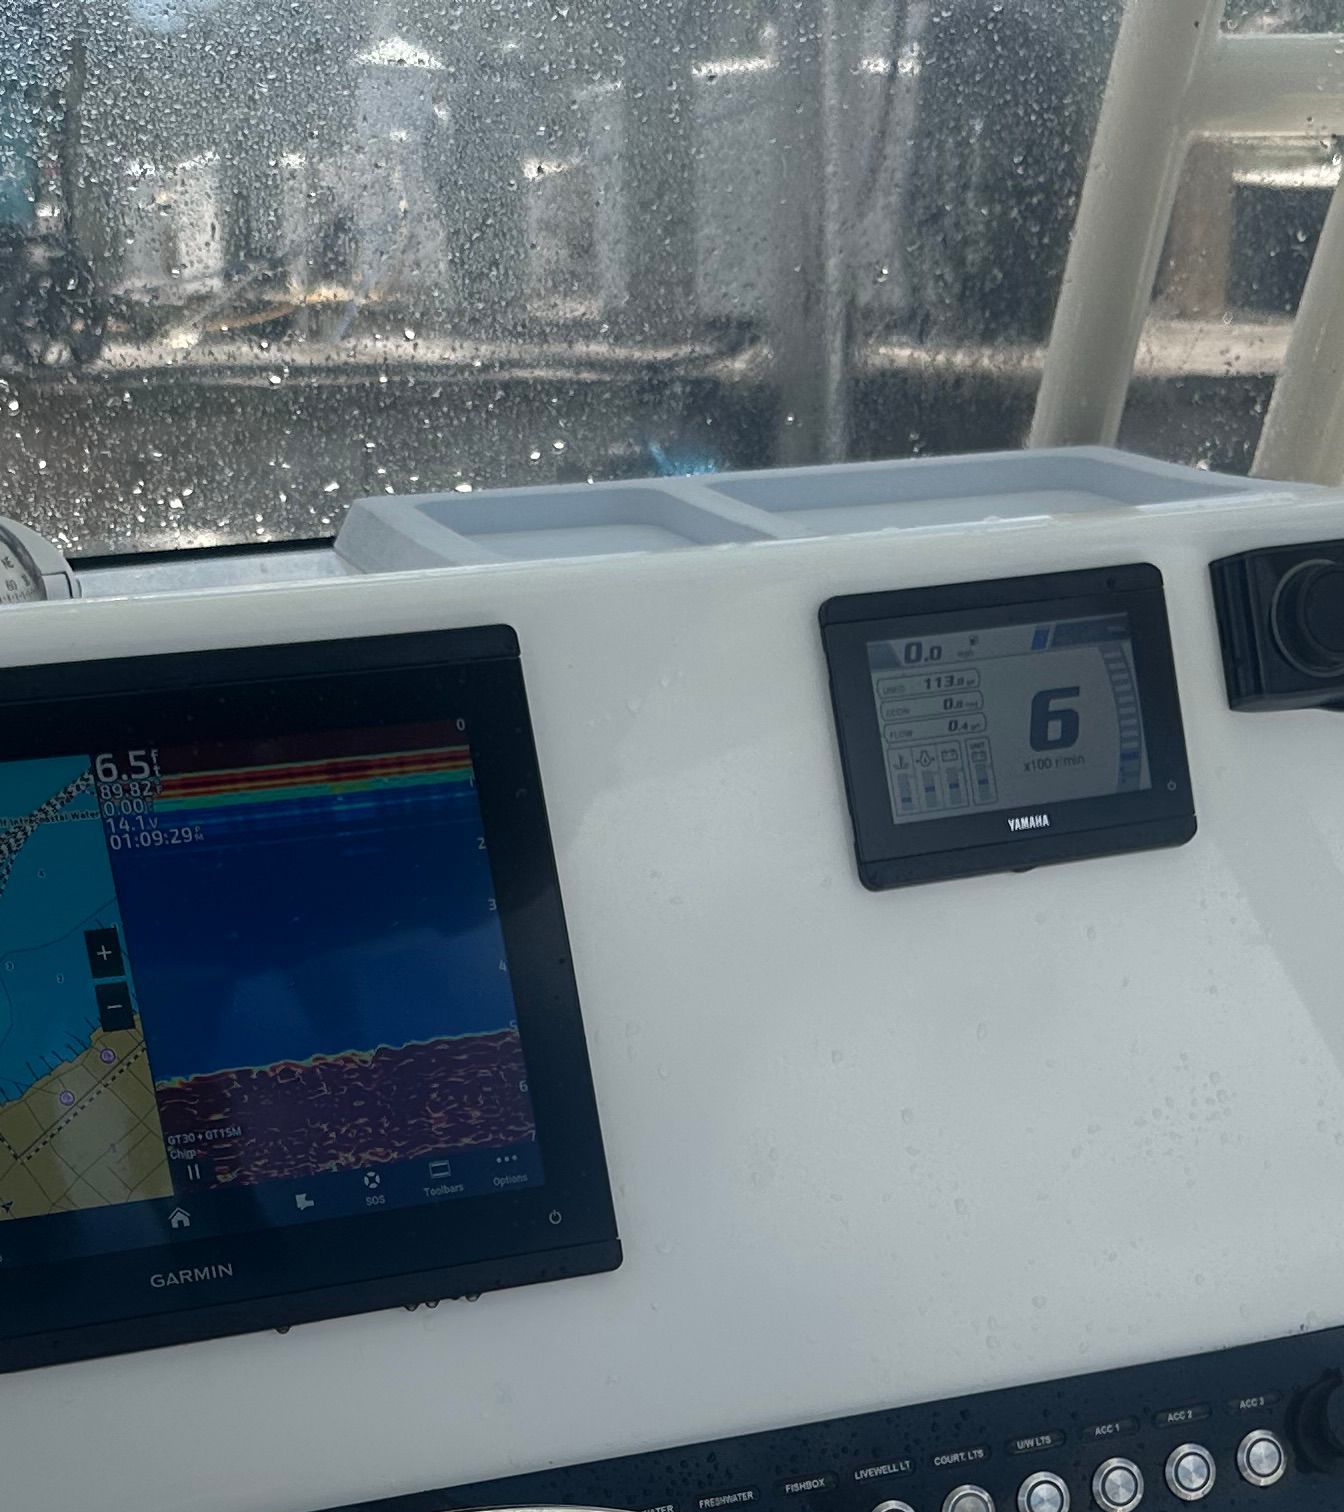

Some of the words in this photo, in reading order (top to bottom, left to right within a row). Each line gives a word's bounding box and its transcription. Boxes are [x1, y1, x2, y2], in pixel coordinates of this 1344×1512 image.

[904, 641, 942, 665] 0.0
[456, 718, 466, 731] 0
[1028, 686, 1081, 752] 6
[95, 750, 151, 783] 6.5
[1023, 757, 1052, 773] x100
[100, 780, 153, 800] 89.82
[71, 809, 101, 821] Water
[1007, 814, 1050, 832] YAMAHA
[110, 826, 193, 850] 01:09:29
[476, 837, 487, 850] 2
[487, 898, 497, 911] 3
[498, 959, 508, 972] 4
[167, 1133, 196, 1145] GT30
[493, 1173, 529, 1188] Options
[423, 1183, 464, 1197] Toolbars
[365, 1195, 386, 1206] SOS
[150, 1260, 234, 1289] GARMIN
[1239, 1398, 1258, 1409] ACC
[1259, 1396, 1265, 1406] 3
[1167, 1412, 1186, 1422] ACC
[1187, 1410, 1193, 1419] 2
[1095, 1426, 1113, 1436] ACC
[1114, 1423, 1120, 1432] 1
[1035, 1435, 1052, 1446] LTS
[967, 1449, 985, 1460] LTS
[854, 1463, 899, 1480] LIVEWELL
[899, 1460, 912, 1471] LT
[784, 1477, 826, 1494] FISHBOX
[698, 1490, 754, 1509] FRESHWATER
